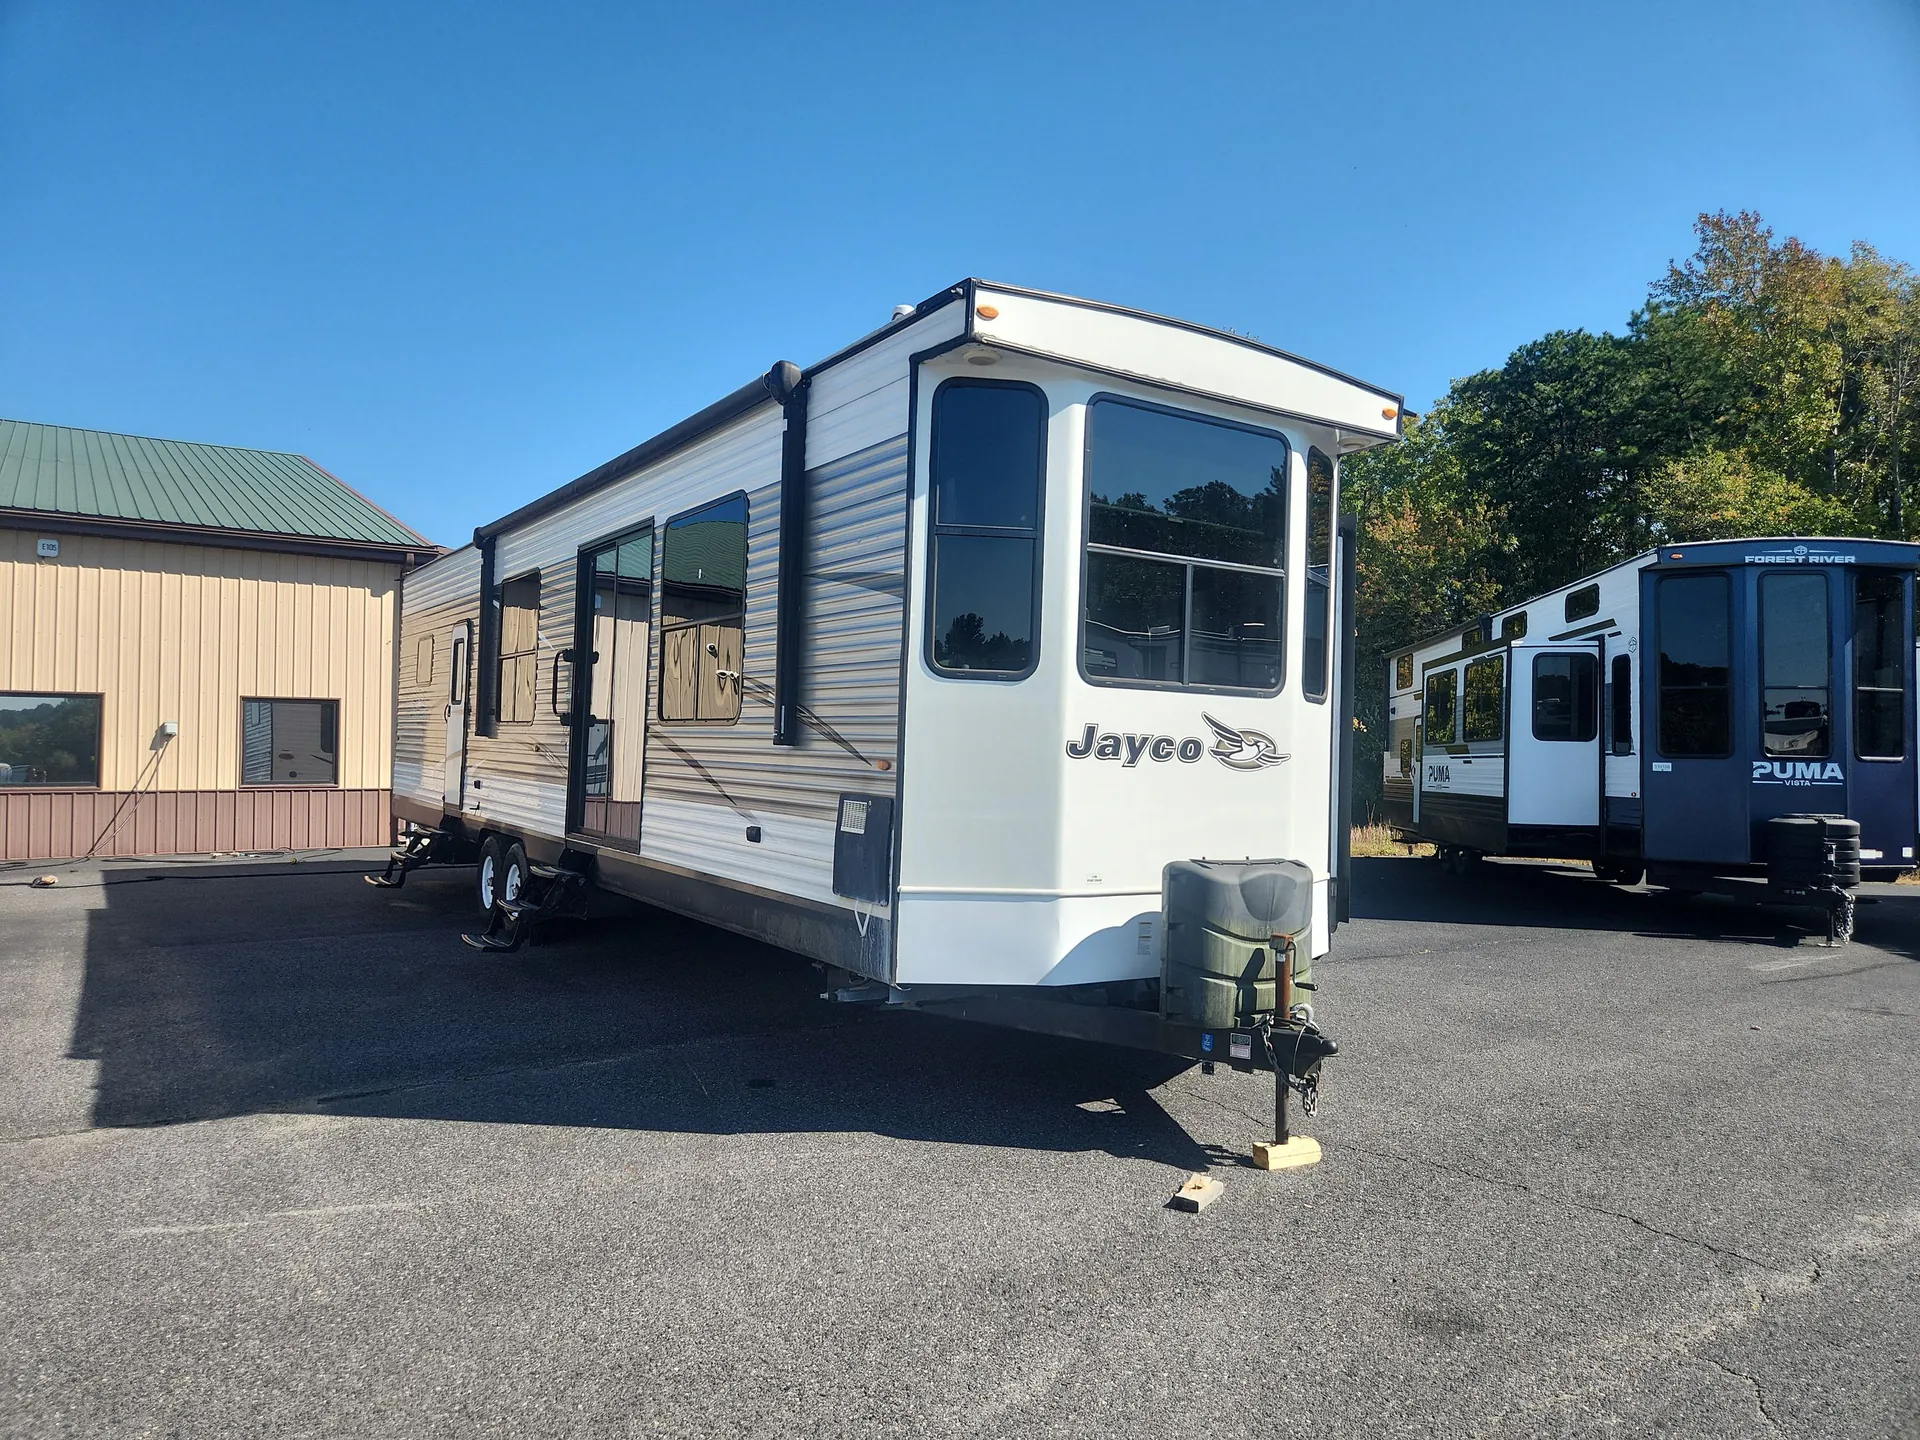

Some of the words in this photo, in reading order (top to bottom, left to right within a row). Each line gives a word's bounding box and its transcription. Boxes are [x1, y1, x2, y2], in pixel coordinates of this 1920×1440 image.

[1744, 555, 1805, 564] FOREST
[1808, 555, 1856, 564] RIVER
[1066, 723, 1204, 767] Jayco
[1428, 765, 1450, 782] PUMA
[1752, 761, 1844, 780] PUMA
